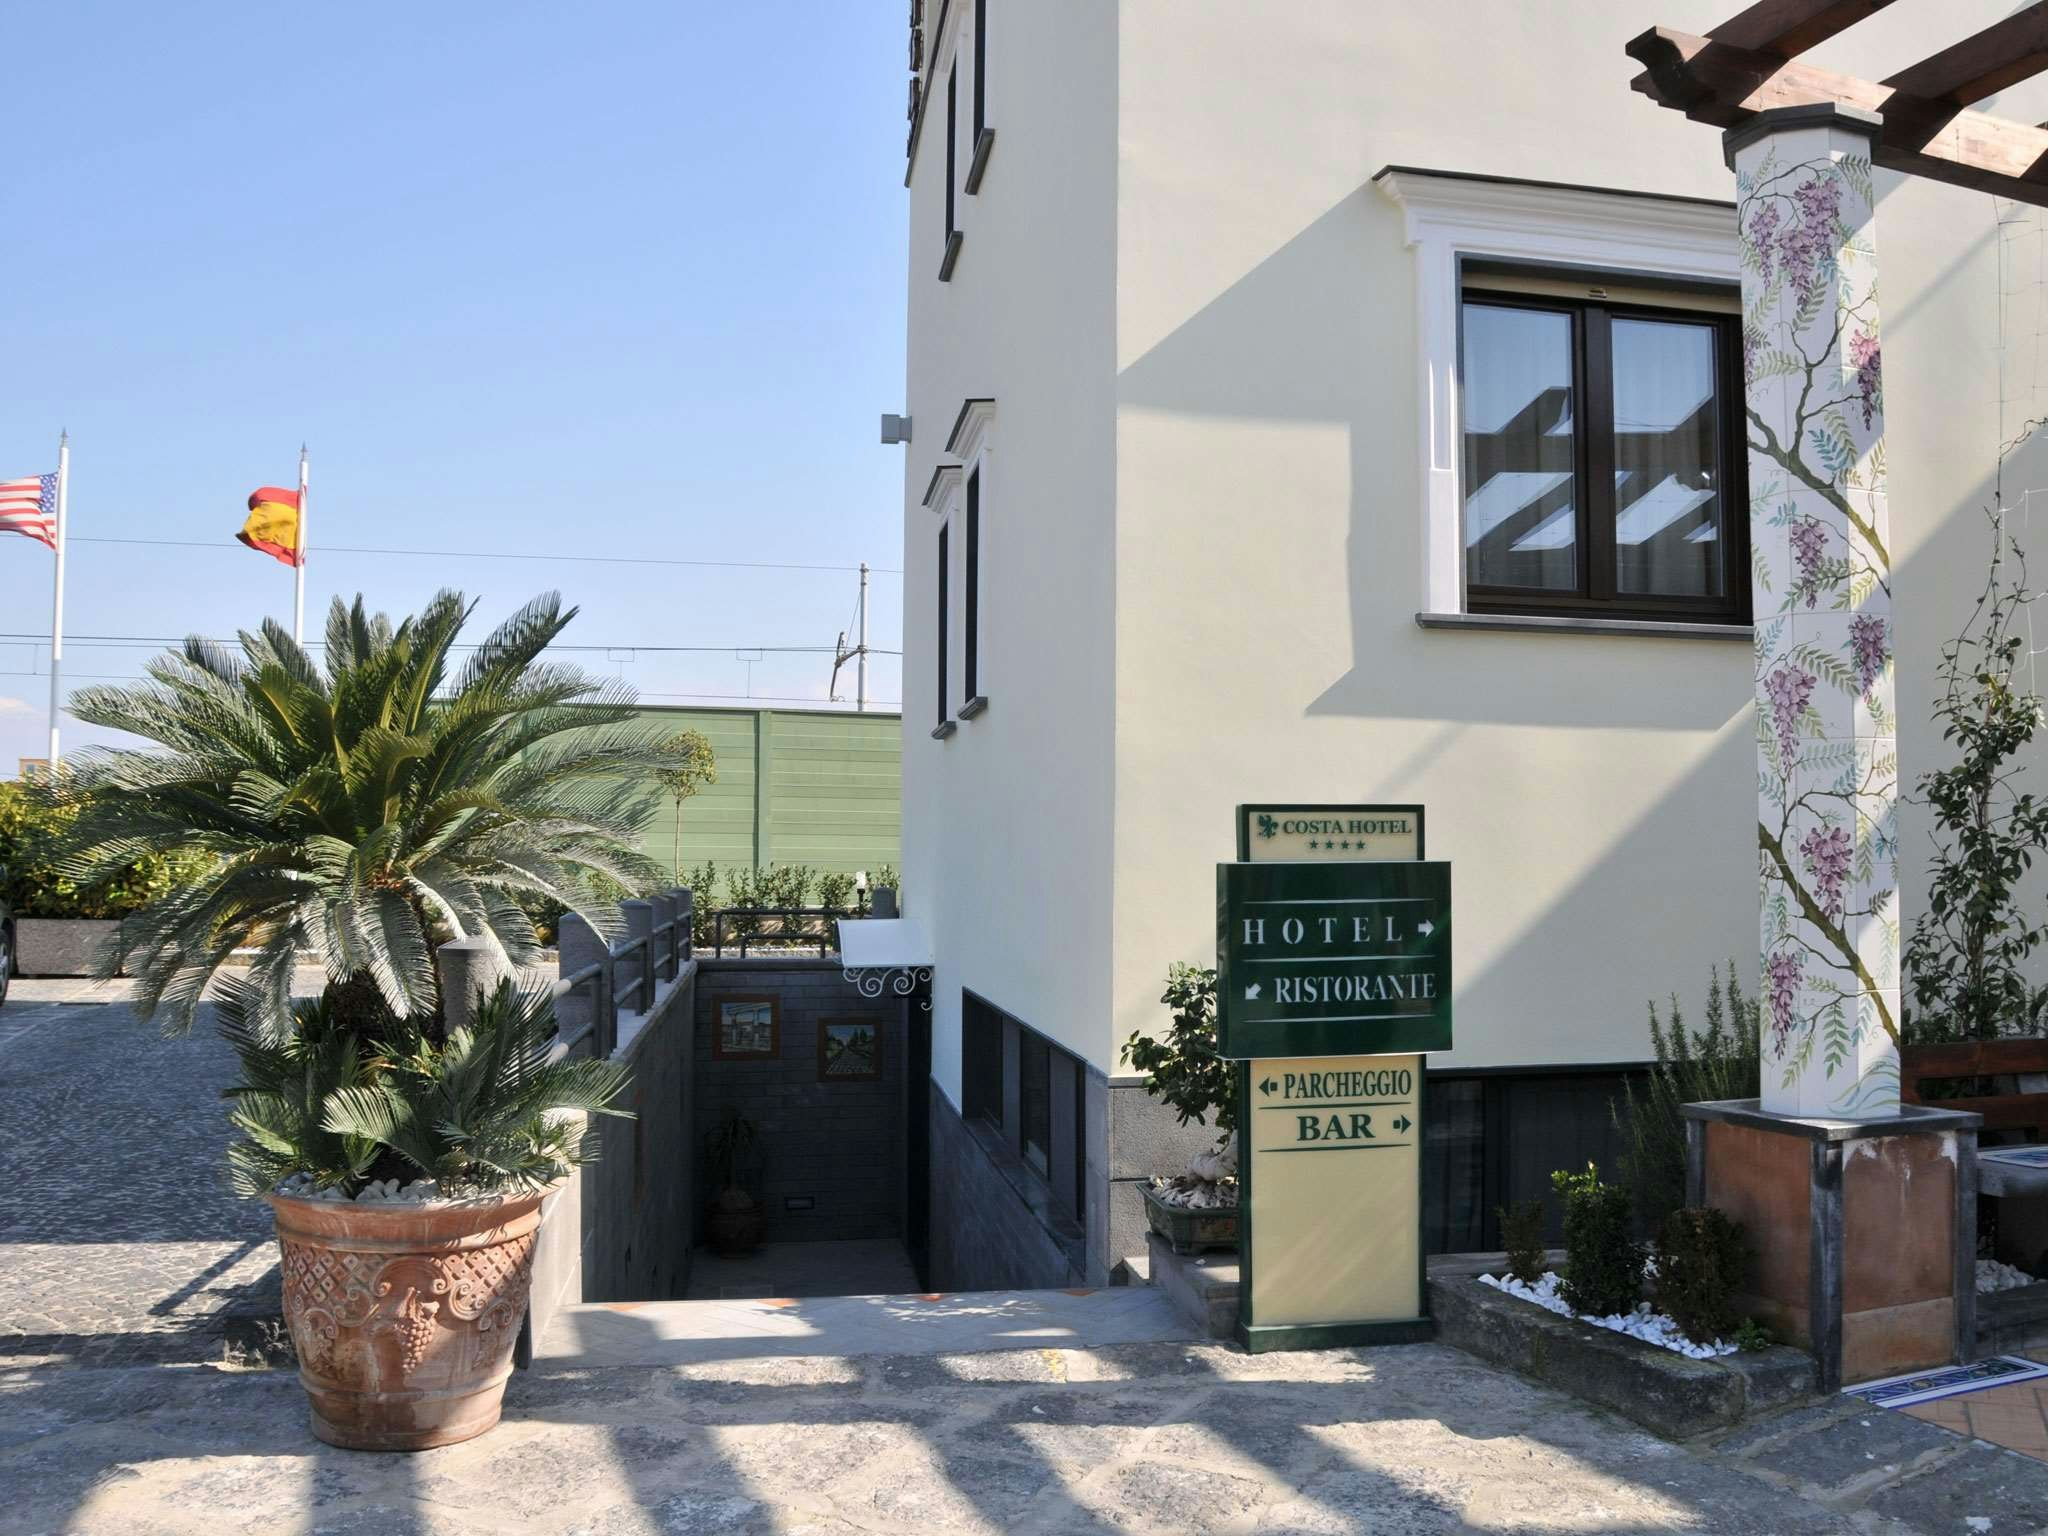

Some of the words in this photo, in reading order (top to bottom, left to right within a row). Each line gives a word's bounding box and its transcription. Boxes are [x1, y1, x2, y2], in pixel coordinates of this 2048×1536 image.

[1283, 820, 1343, 834] COSTA
[1349, 819, 1412, 834] HOTEL
[1242, 916, 1403, 945] HOTEL
[1275, 973, 1437, 1003] RISTORANTE
[1283, 1069, 1412, 1099] PARCHEGGIO
[1297, 1113, 1376, 1142] BAR
